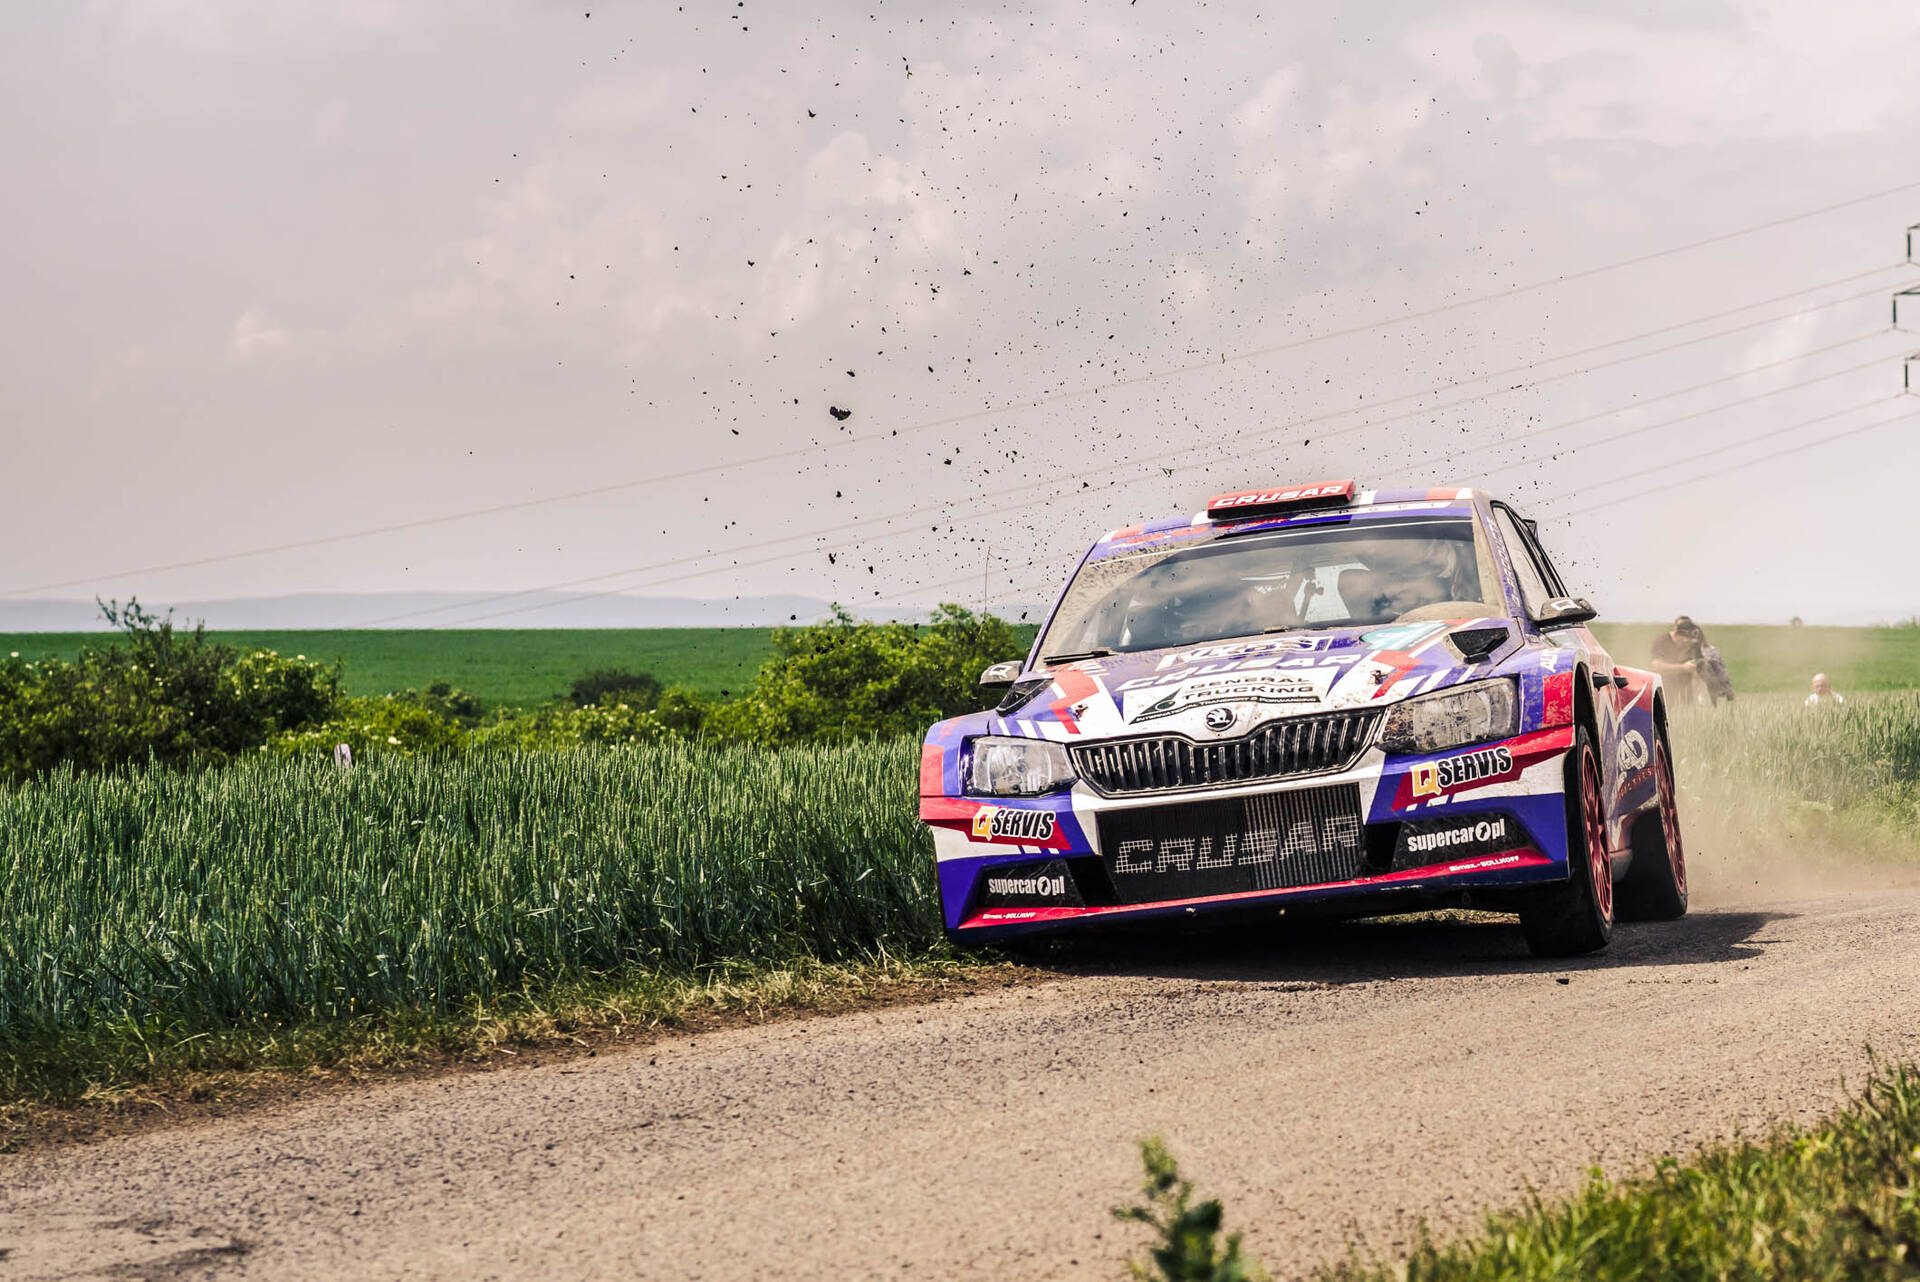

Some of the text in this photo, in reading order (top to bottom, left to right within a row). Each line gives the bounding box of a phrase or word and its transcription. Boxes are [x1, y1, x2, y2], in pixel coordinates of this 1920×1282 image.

[1213, 485, 1344, 508] CRUSAR
[1113, 653, 1363, 692] CRUSAR
[1190, 677, 1311, 690] GENERAL
[1182, 686, 1314, 700] TRUCKING
[1437, 746, 1512, 788] SERVIS
[991, 807, 1056, 840] SERVIS
